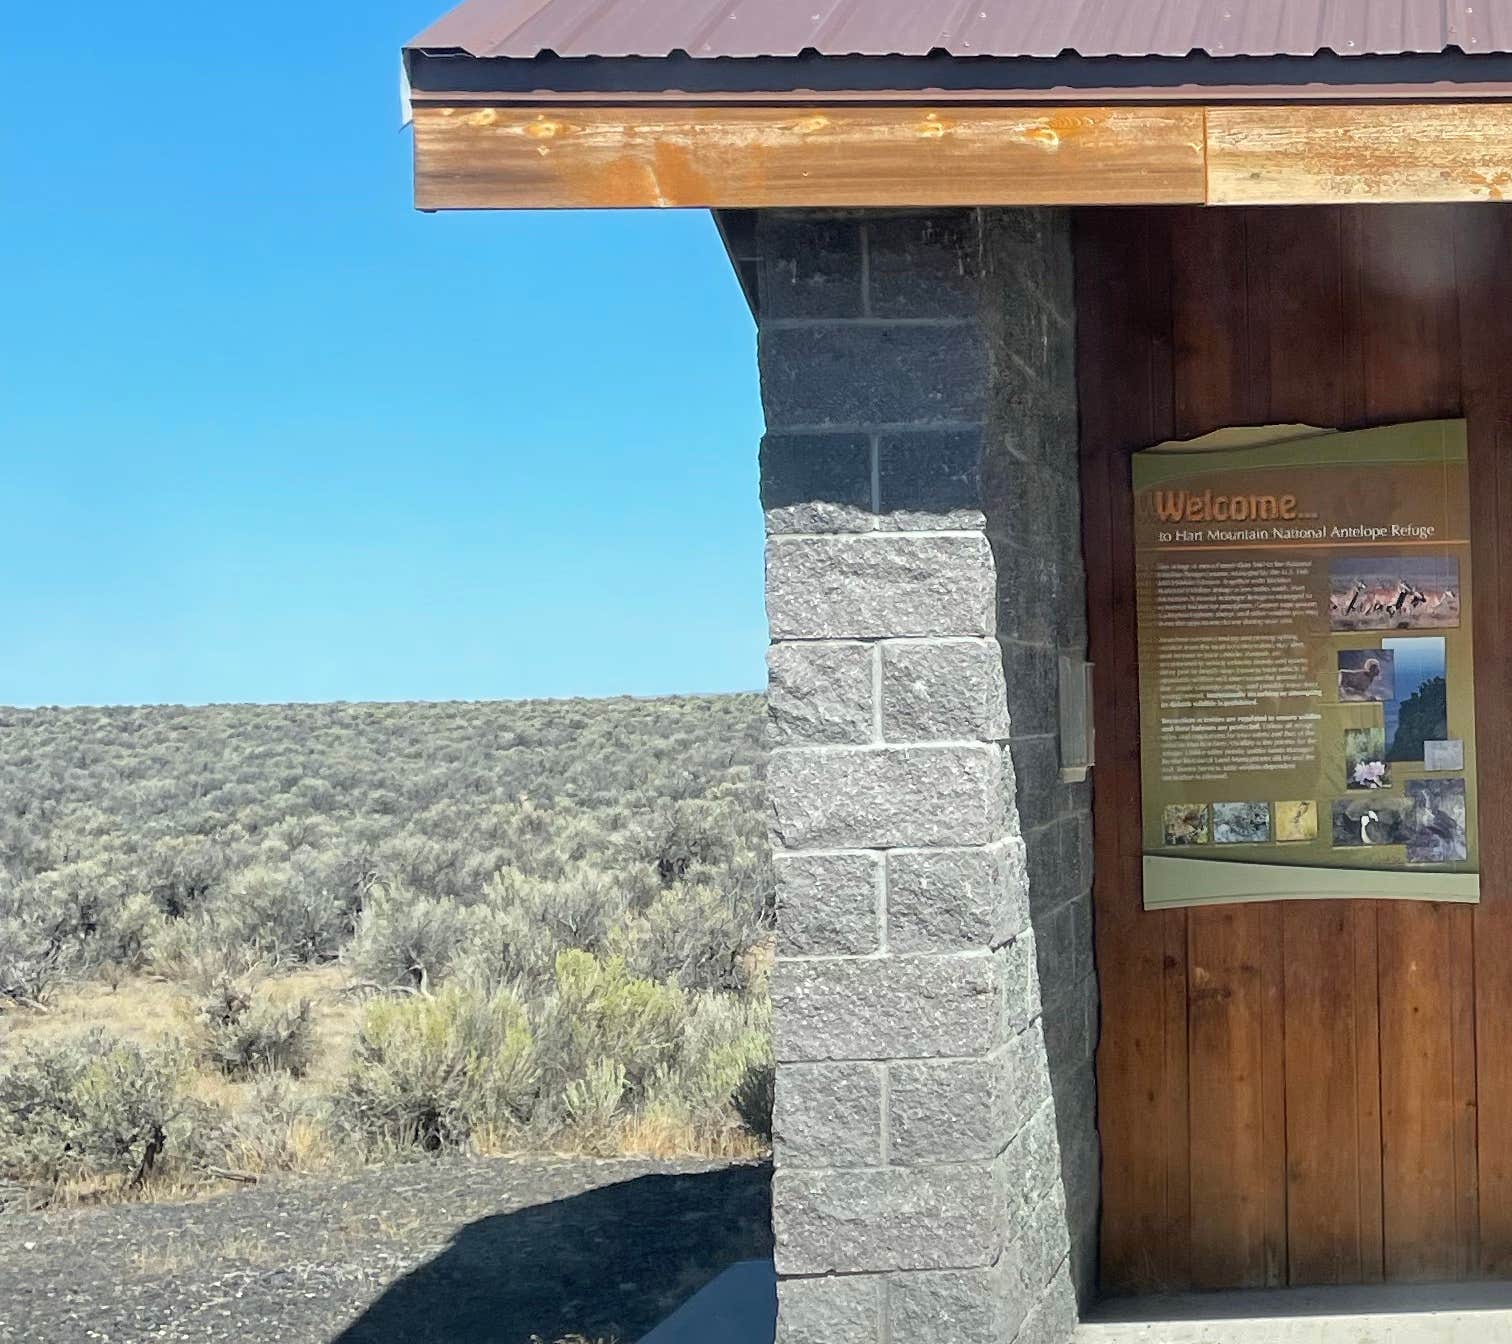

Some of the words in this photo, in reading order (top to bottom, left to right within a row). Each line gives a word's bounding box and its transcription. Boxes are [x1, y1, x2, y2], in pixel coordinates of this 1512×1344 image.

[1159, 531, 1172, 542] to
[1175, 529, 1203, 541] Hart
[1207, 527, 1269, 542] Mountain
[1272, 526, 1327, 539] National
[1330, 524, 1388, 540] Antelope
[1391, 523, 1435, 539] Refuge
